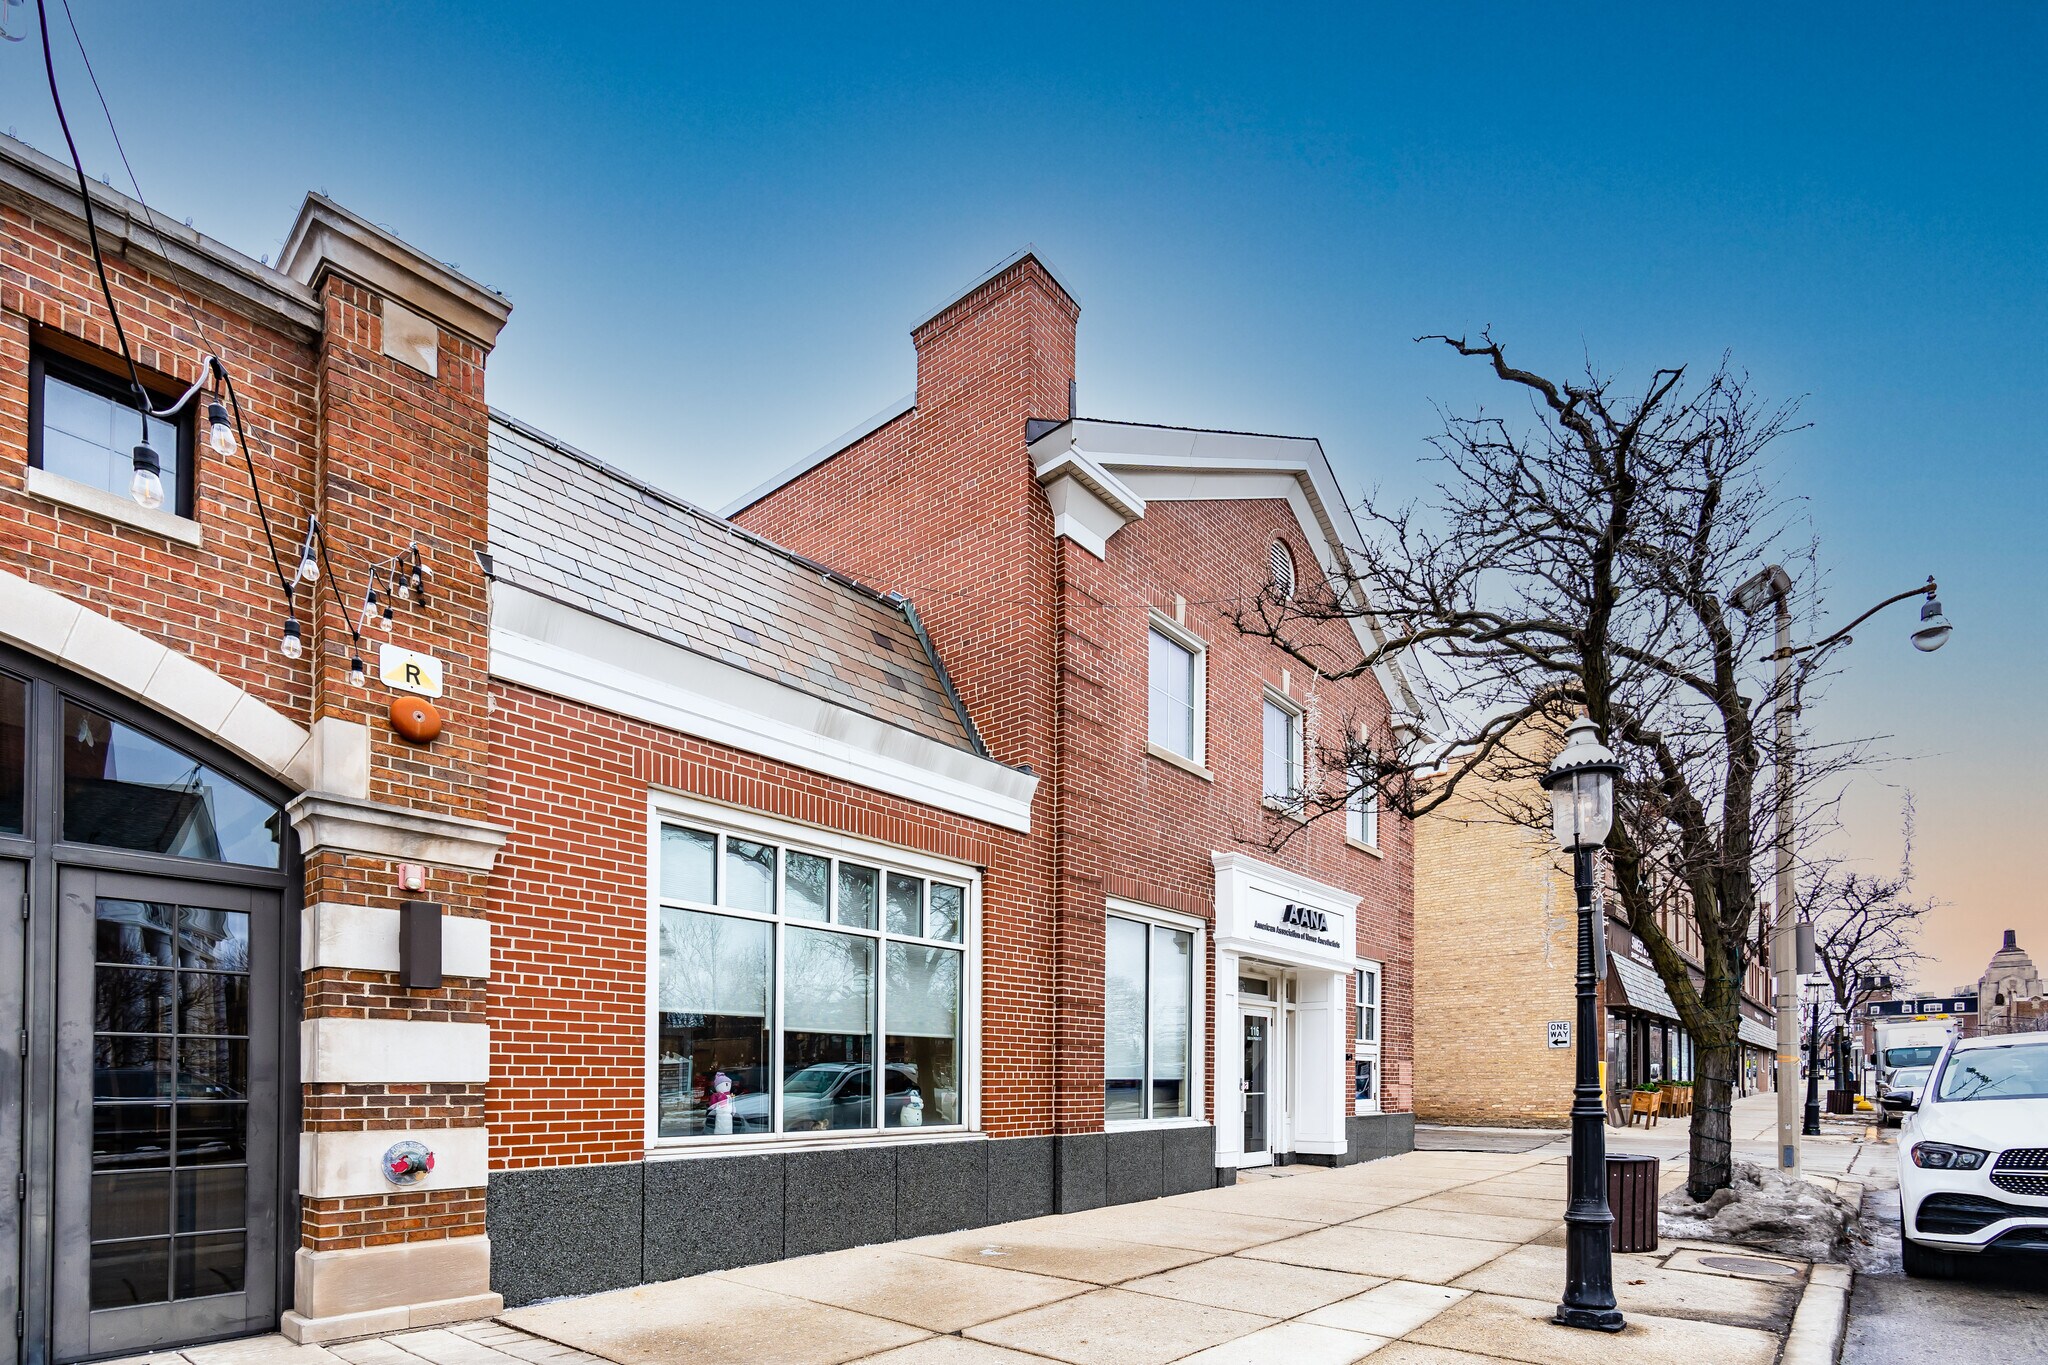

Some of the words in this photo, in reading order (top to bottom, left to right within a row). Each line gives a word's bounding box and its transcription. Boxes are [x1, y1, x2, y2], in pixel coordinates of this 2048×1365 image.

[405, 663, 421, 686] R
[1282, 904, 1329, 932] AANA
[1253, 920, 1276, 932] American
[1275, 926, 1301, 939] Association
[1300, 932, 1306, 940] of
